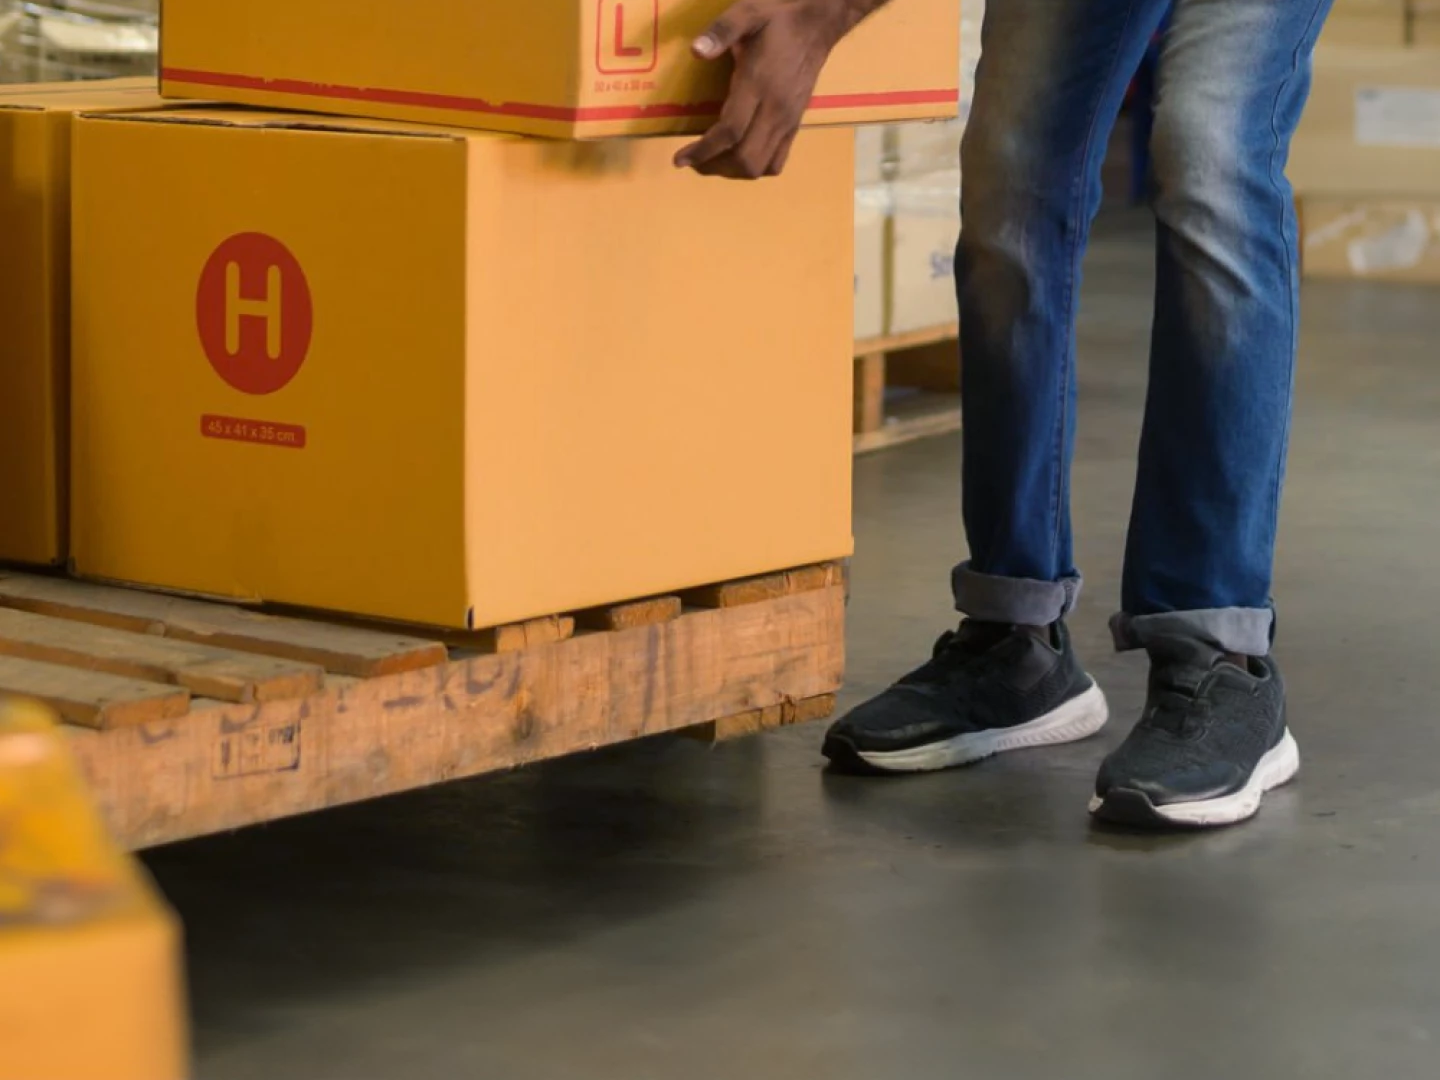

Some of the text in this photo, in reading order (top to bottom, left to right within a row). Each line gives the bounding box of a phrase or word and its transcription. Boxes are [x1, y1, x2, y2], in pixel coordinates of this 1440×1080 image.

[615, 2, 642, 56] L
[226, 261, 282, 359] H
[208, 420, 223, 434] 45
[225, 425, 233, 434] x
[233, 423, 248, 437] 41
[251, 428, 259, 439] x
[261, 426, 276, 440] 35
